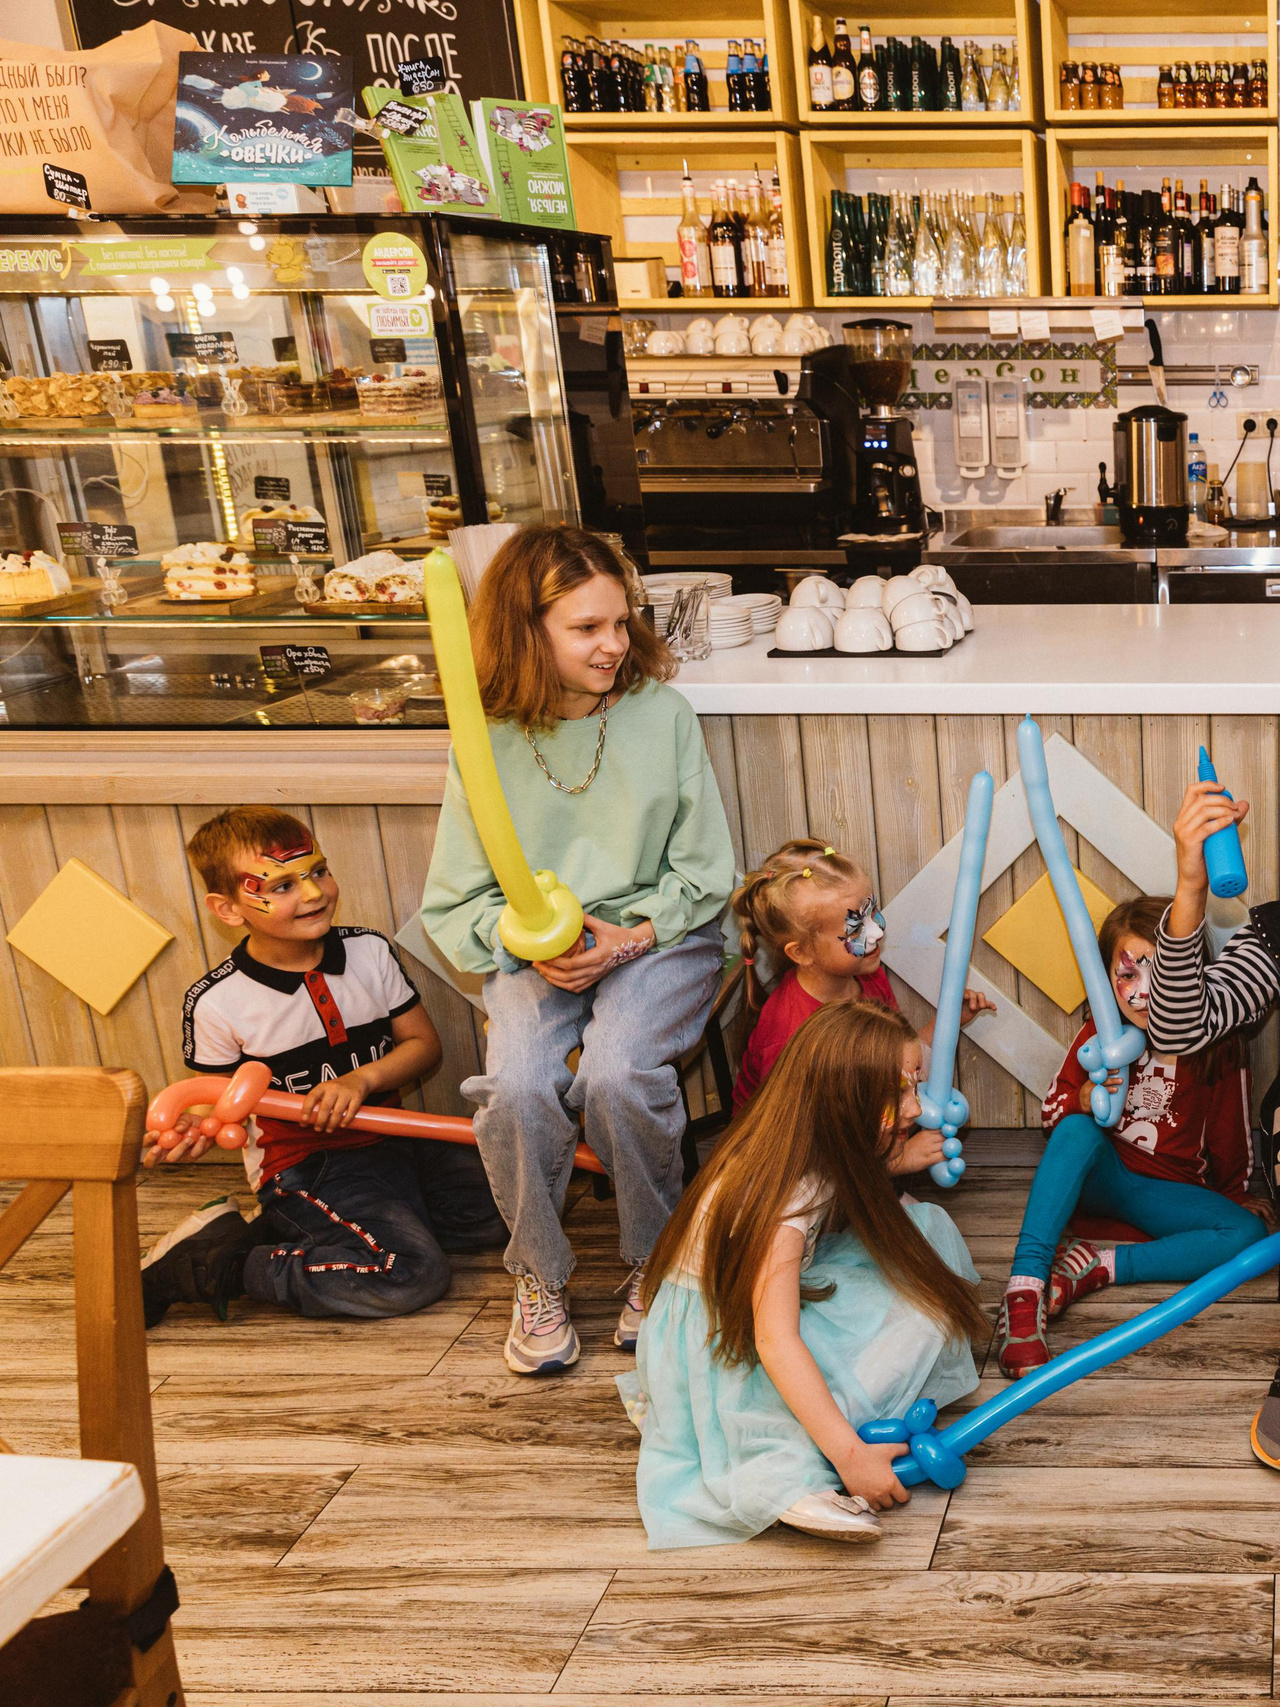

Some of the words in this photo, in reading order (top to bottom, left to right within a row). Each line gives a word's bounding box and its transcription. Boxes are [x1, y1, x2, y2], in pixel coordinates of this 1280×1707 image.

[45, 64, 87, 88] БЫЛ?
[886, 70, 895, 103] BADOIT
[911, 70, 920, 103] BADOIT
[31, 94, 70, 121] МЕНЯ
[29, 129, 51, 154] НЕ
[52, 125, 92, 153] БЫЛО
[203, 119, 323, 154] Колыбельная
[527, 179, 566, 196] МОЖНО
[832, 241, 844, 284] BADOIT
[184, 978, 211, 1018] captain
[184, 1021, 193, 1060] captain
[331, 1263, 349, 1271] STAY
